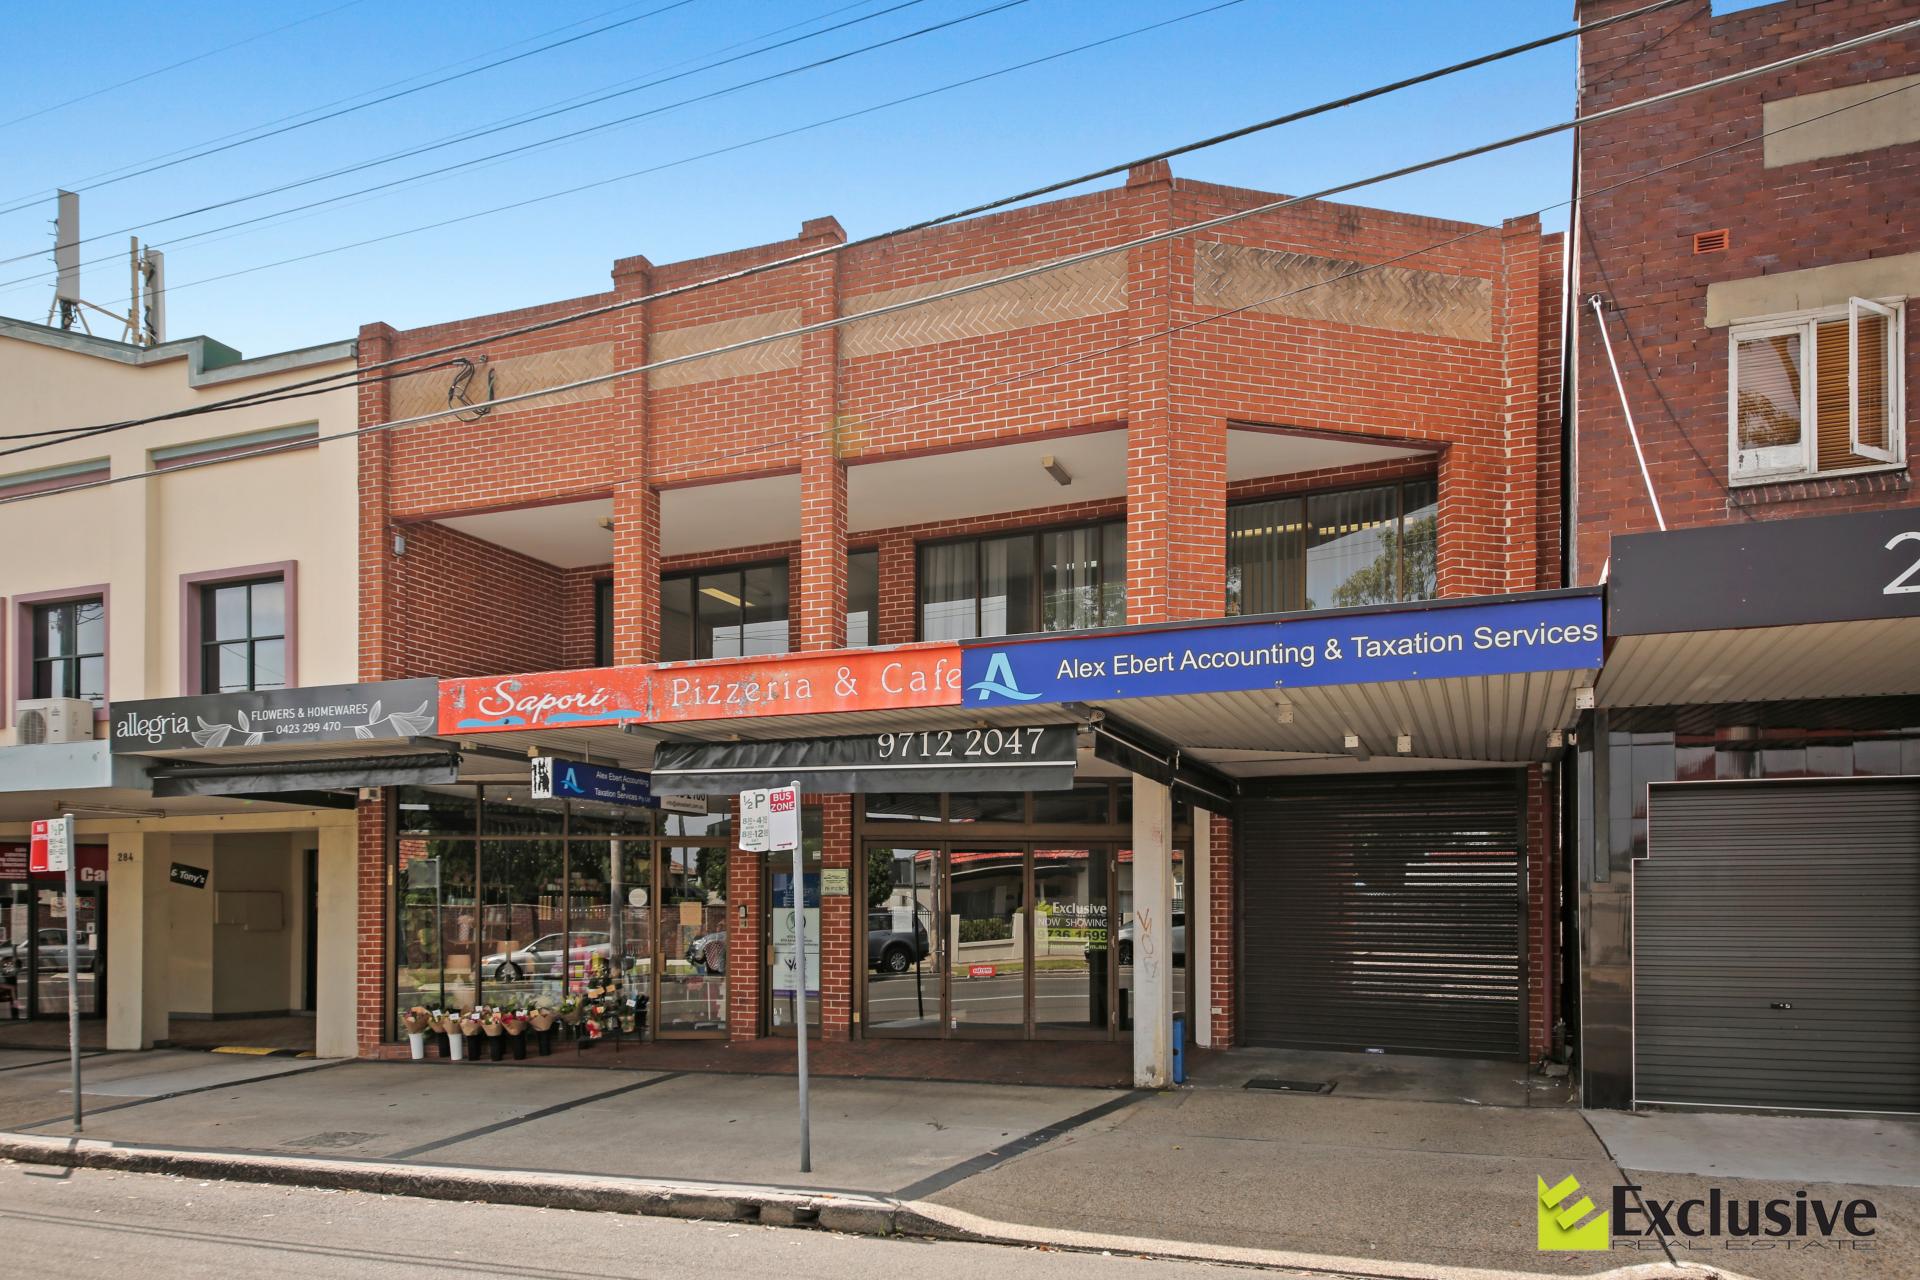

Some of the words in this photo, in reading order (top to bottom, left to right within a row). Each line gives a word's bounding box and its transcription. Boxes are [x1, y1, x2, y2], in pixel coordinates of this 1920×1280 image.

[1883, 531, 1920, 595] 2
[1056, 658, 1106, 680] Alex
[1113, 652, 1174, 676] Ebert
[1180, 643, 1315, 671] Accounting
[1324, 638, 1343, 660] &
[1351, 632, 1463, 658] Taxation
[1473, 622, 1598, 650] Services
[671, 677, 812, 707] Pizzeria
[834, 665, 858, 696] &
[881, 658, 962, 694] Cafe
[478, 680, 608, 723] Sapori
[251, 708, 296, 721] FLOWERS
[297, 707, 305, 718] &
[307, 703, 368, 717] HOMEWARES
[116, 712, 190, 744] allegria
[276, 724, 300, 735] 0423
[302, 722, 320, 733] 299
[322, 721, 341, 732] 470
[877, 731, 953, 758] 9712
[964, 727, 1044, 757] 2047
[595, 770, 608, 780] Alex
[608, 772, 622, 782] Ebert
[622, 775, 649, 788] Accounting
[594, 787, 616, 798] Taxation
[616, 790, 638, 801] Services
[772, 791, 792, 802] BUS
[770, 801, 796, 812] ZONE
[117, 852, 134, 862] 284
[81, 866, 109, 882] Ca
[170, 868, 178, 877] &
[179, 870, 206, 884] Tony's
[1052, 901, 1108, 914] Exclusive
[1038, 917, 1060, 928] NOW
[1065, 918, 1108, 928] SHOWING
